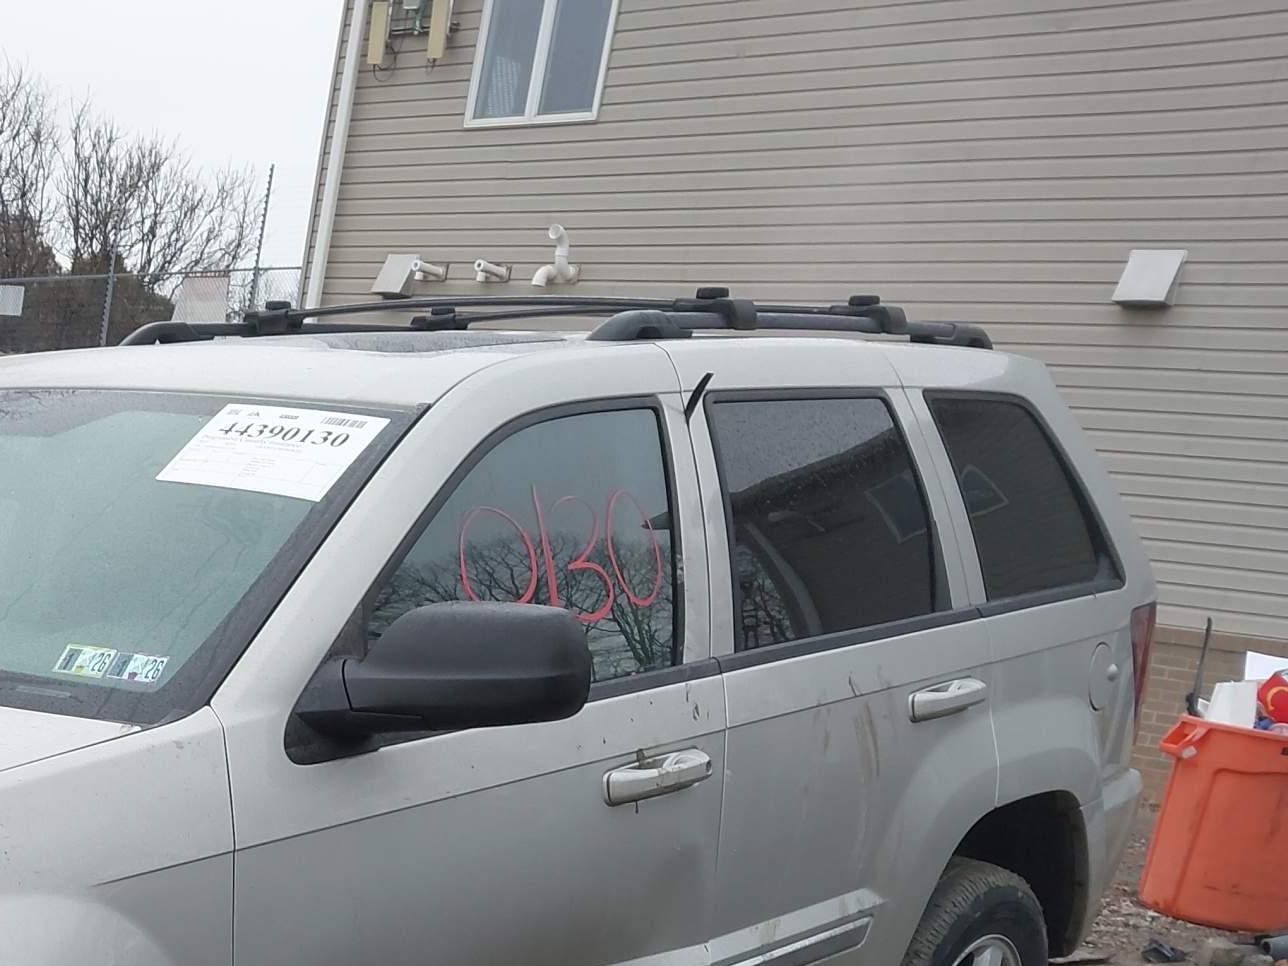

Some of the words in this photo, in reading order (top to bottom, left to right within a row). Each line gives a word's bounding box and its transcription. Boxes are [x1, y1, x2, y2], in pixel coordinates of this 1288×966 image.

[219, 422, 350, 448] 44390130
[91, 652, 112, 673] 26
[144, 659, 165, 680] 26
